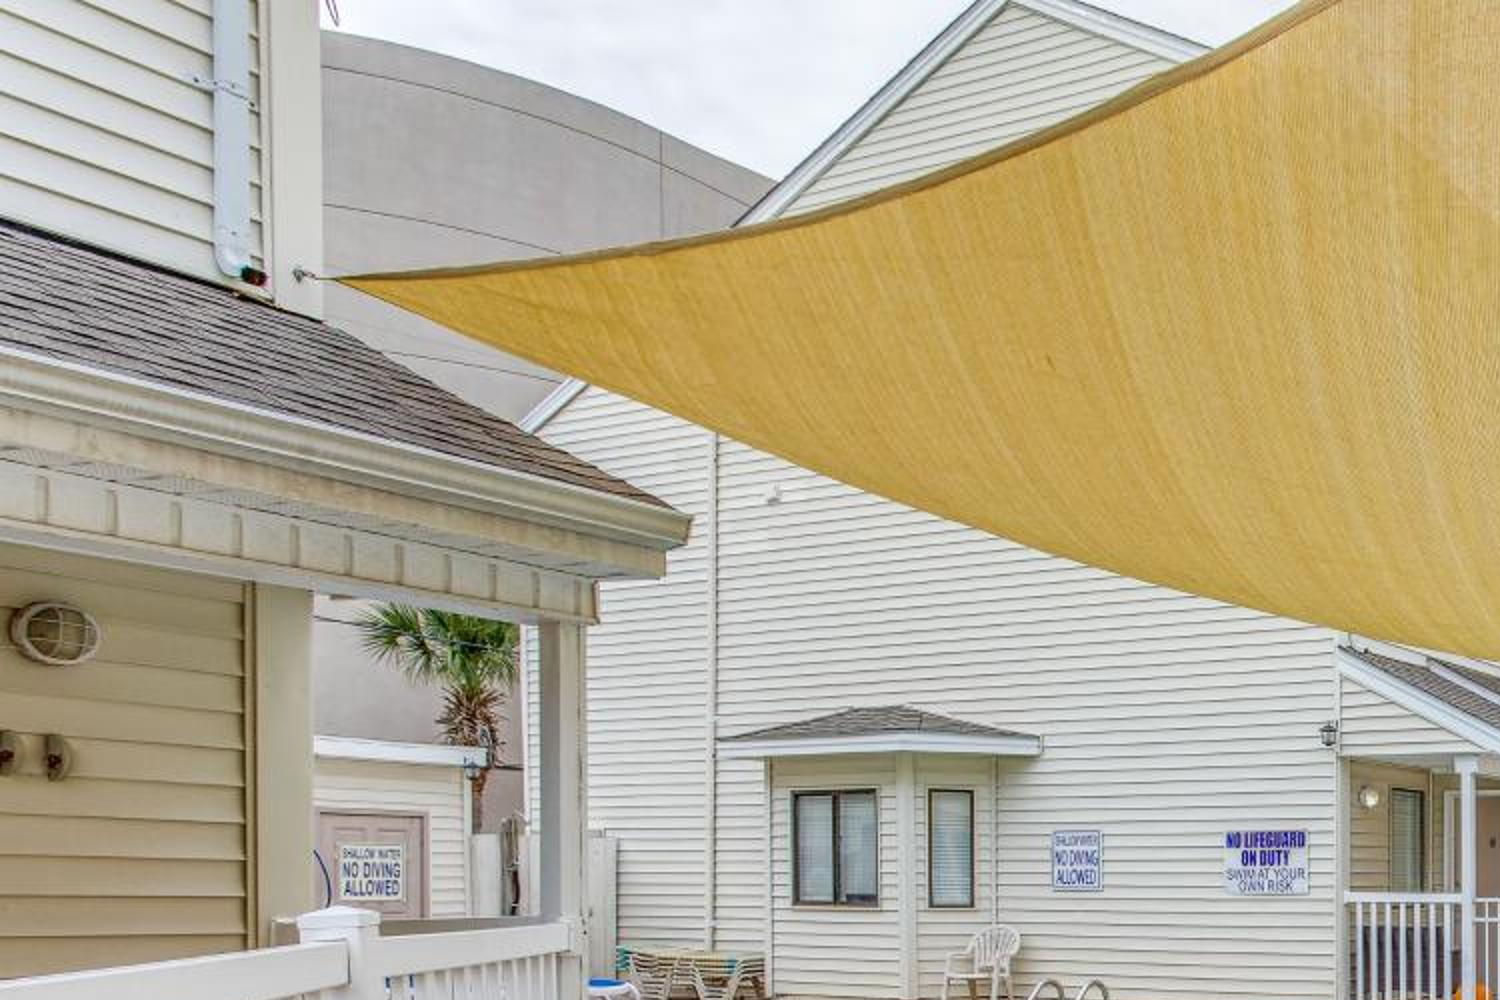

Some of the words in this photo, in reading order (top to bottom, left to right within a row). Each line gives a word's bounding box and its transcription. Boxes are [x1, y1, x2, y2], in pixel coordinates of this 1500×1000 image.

[1226, 831, 1241, 848] NO
[1244, 831, 1306, 848] LIFEGUARD
[343, 847, 375, 859] SHALLOW
[1055, 849, 1068, 866] NO
[1070, 849, 1099, 866] DIVING
[1241, 850, 1257, 866] ON
[1260, 850, 1290, 866] DUTY
[343, 861, 359, 878] NO
[363, 861, 401, 878] DIVING
[1056, 869, 1096, 885] ALLOWED
[1258, 867, 1270, 880] AT
[1274, 867, 1306, 880] YOUR
[343, 880, 400, 897] ALLOWED
[1239, 880, 1265, 892] OWN
[1268, 880, 1293, 892] RISK
